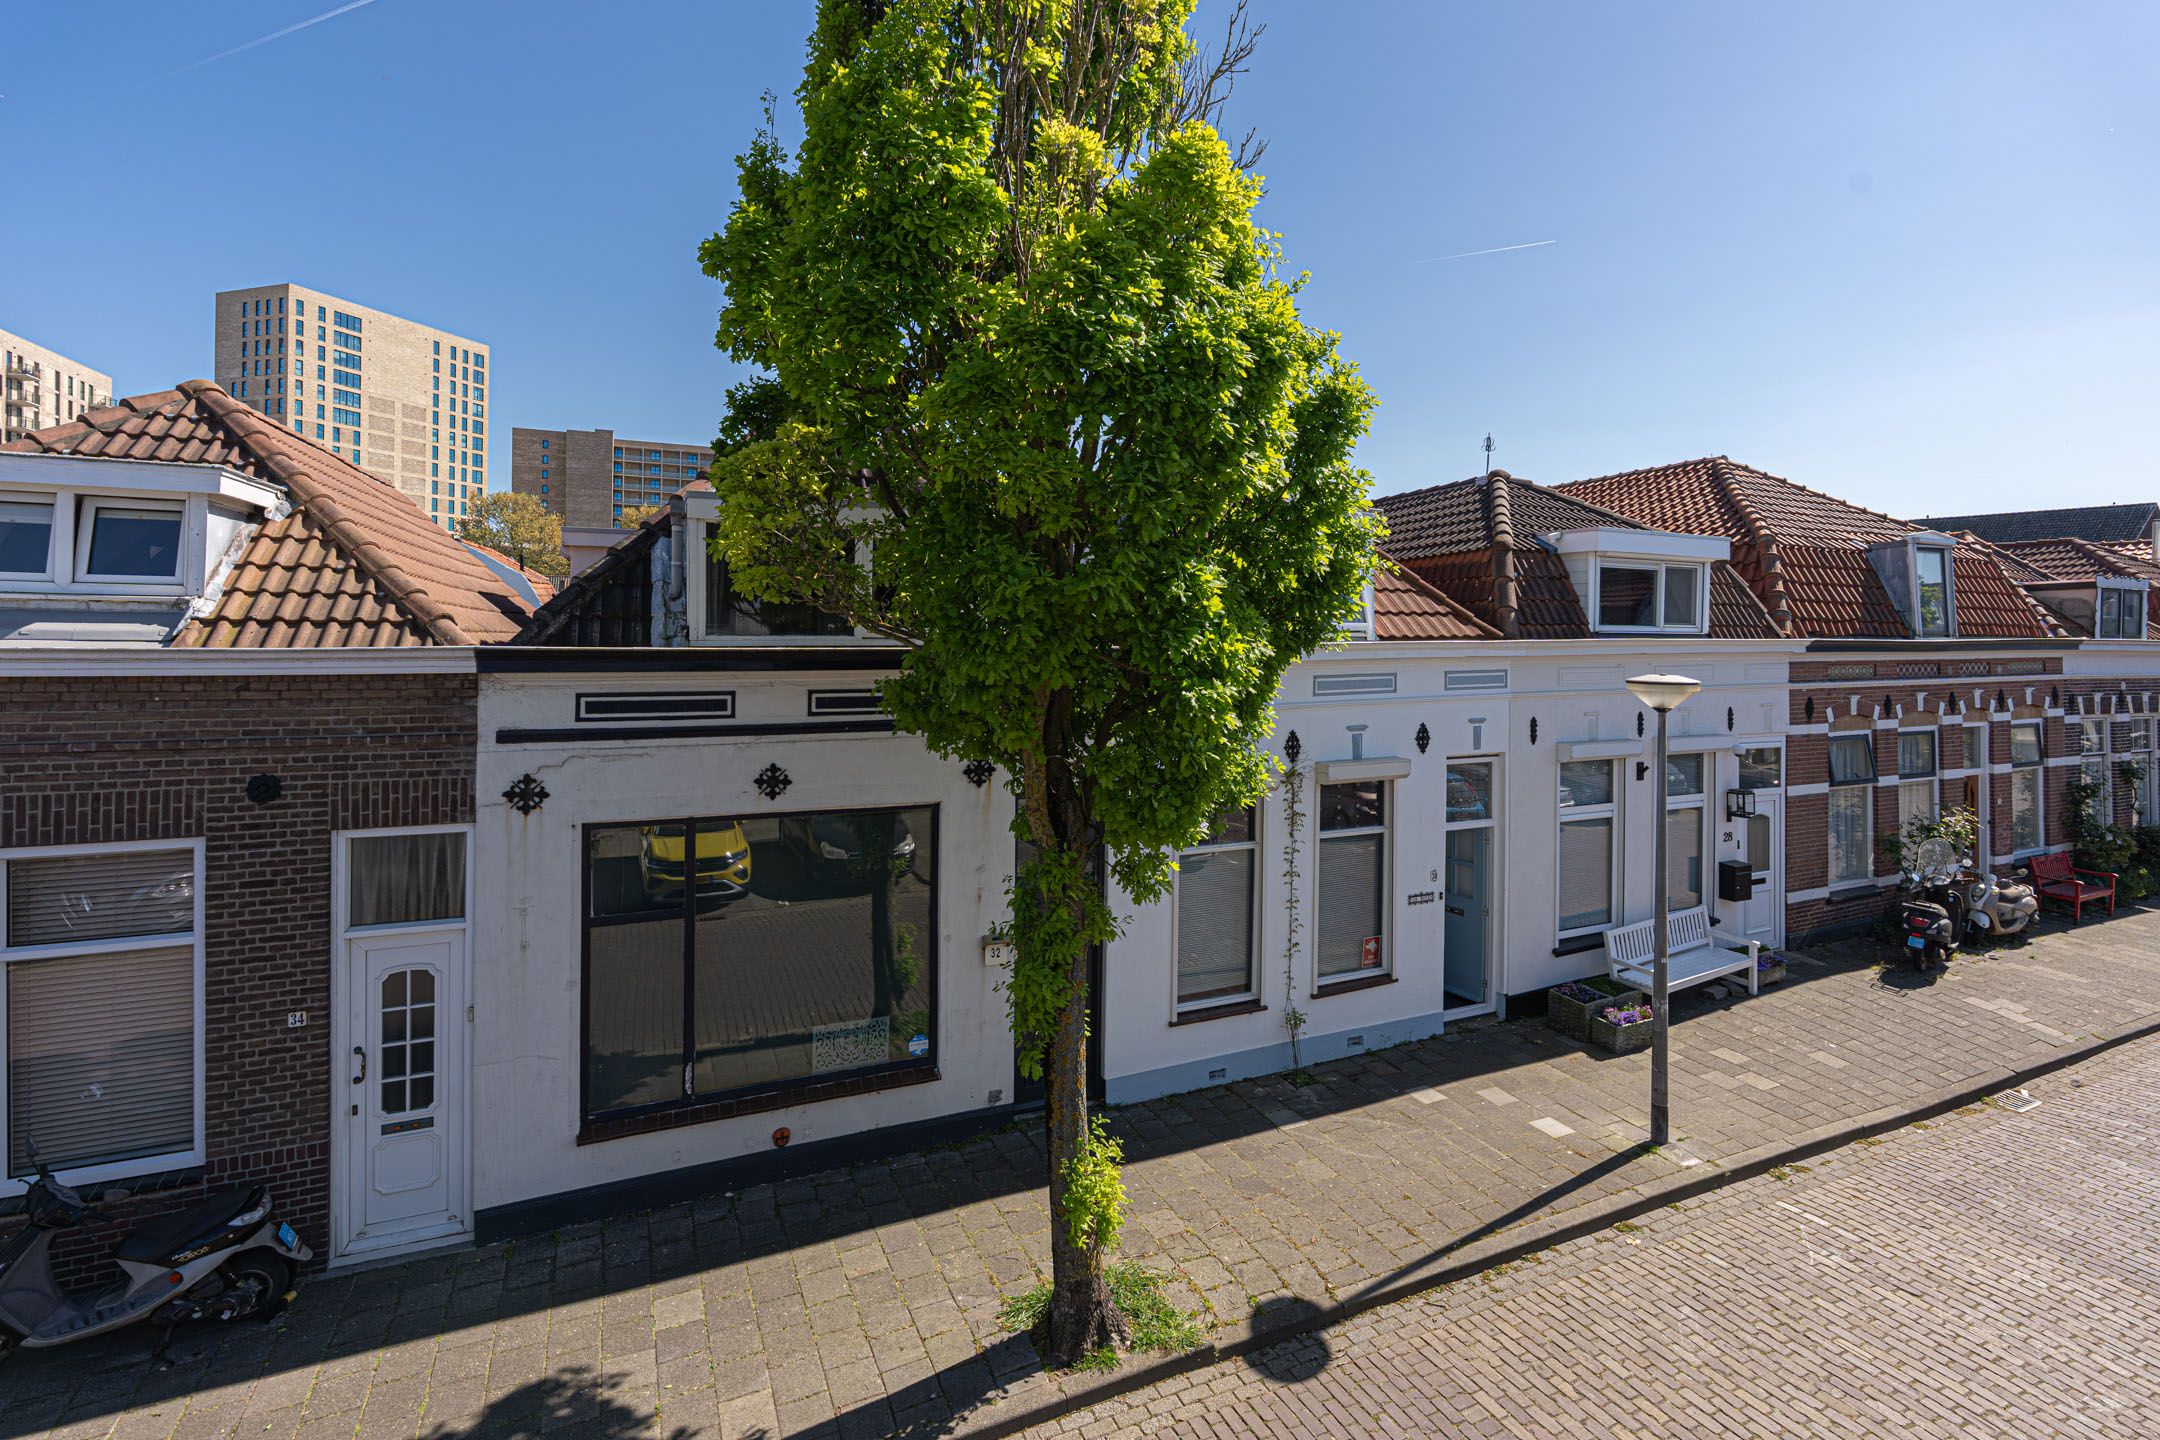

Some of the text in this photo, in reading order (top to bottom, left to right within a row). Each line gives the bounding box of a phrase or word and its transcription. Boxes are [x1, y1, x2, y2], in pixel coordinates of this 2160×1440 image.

[1723, 831, 1733, 842] 28
[991, 947, 1001, 958] 32
[290, 1012, 304, 1025] 34
